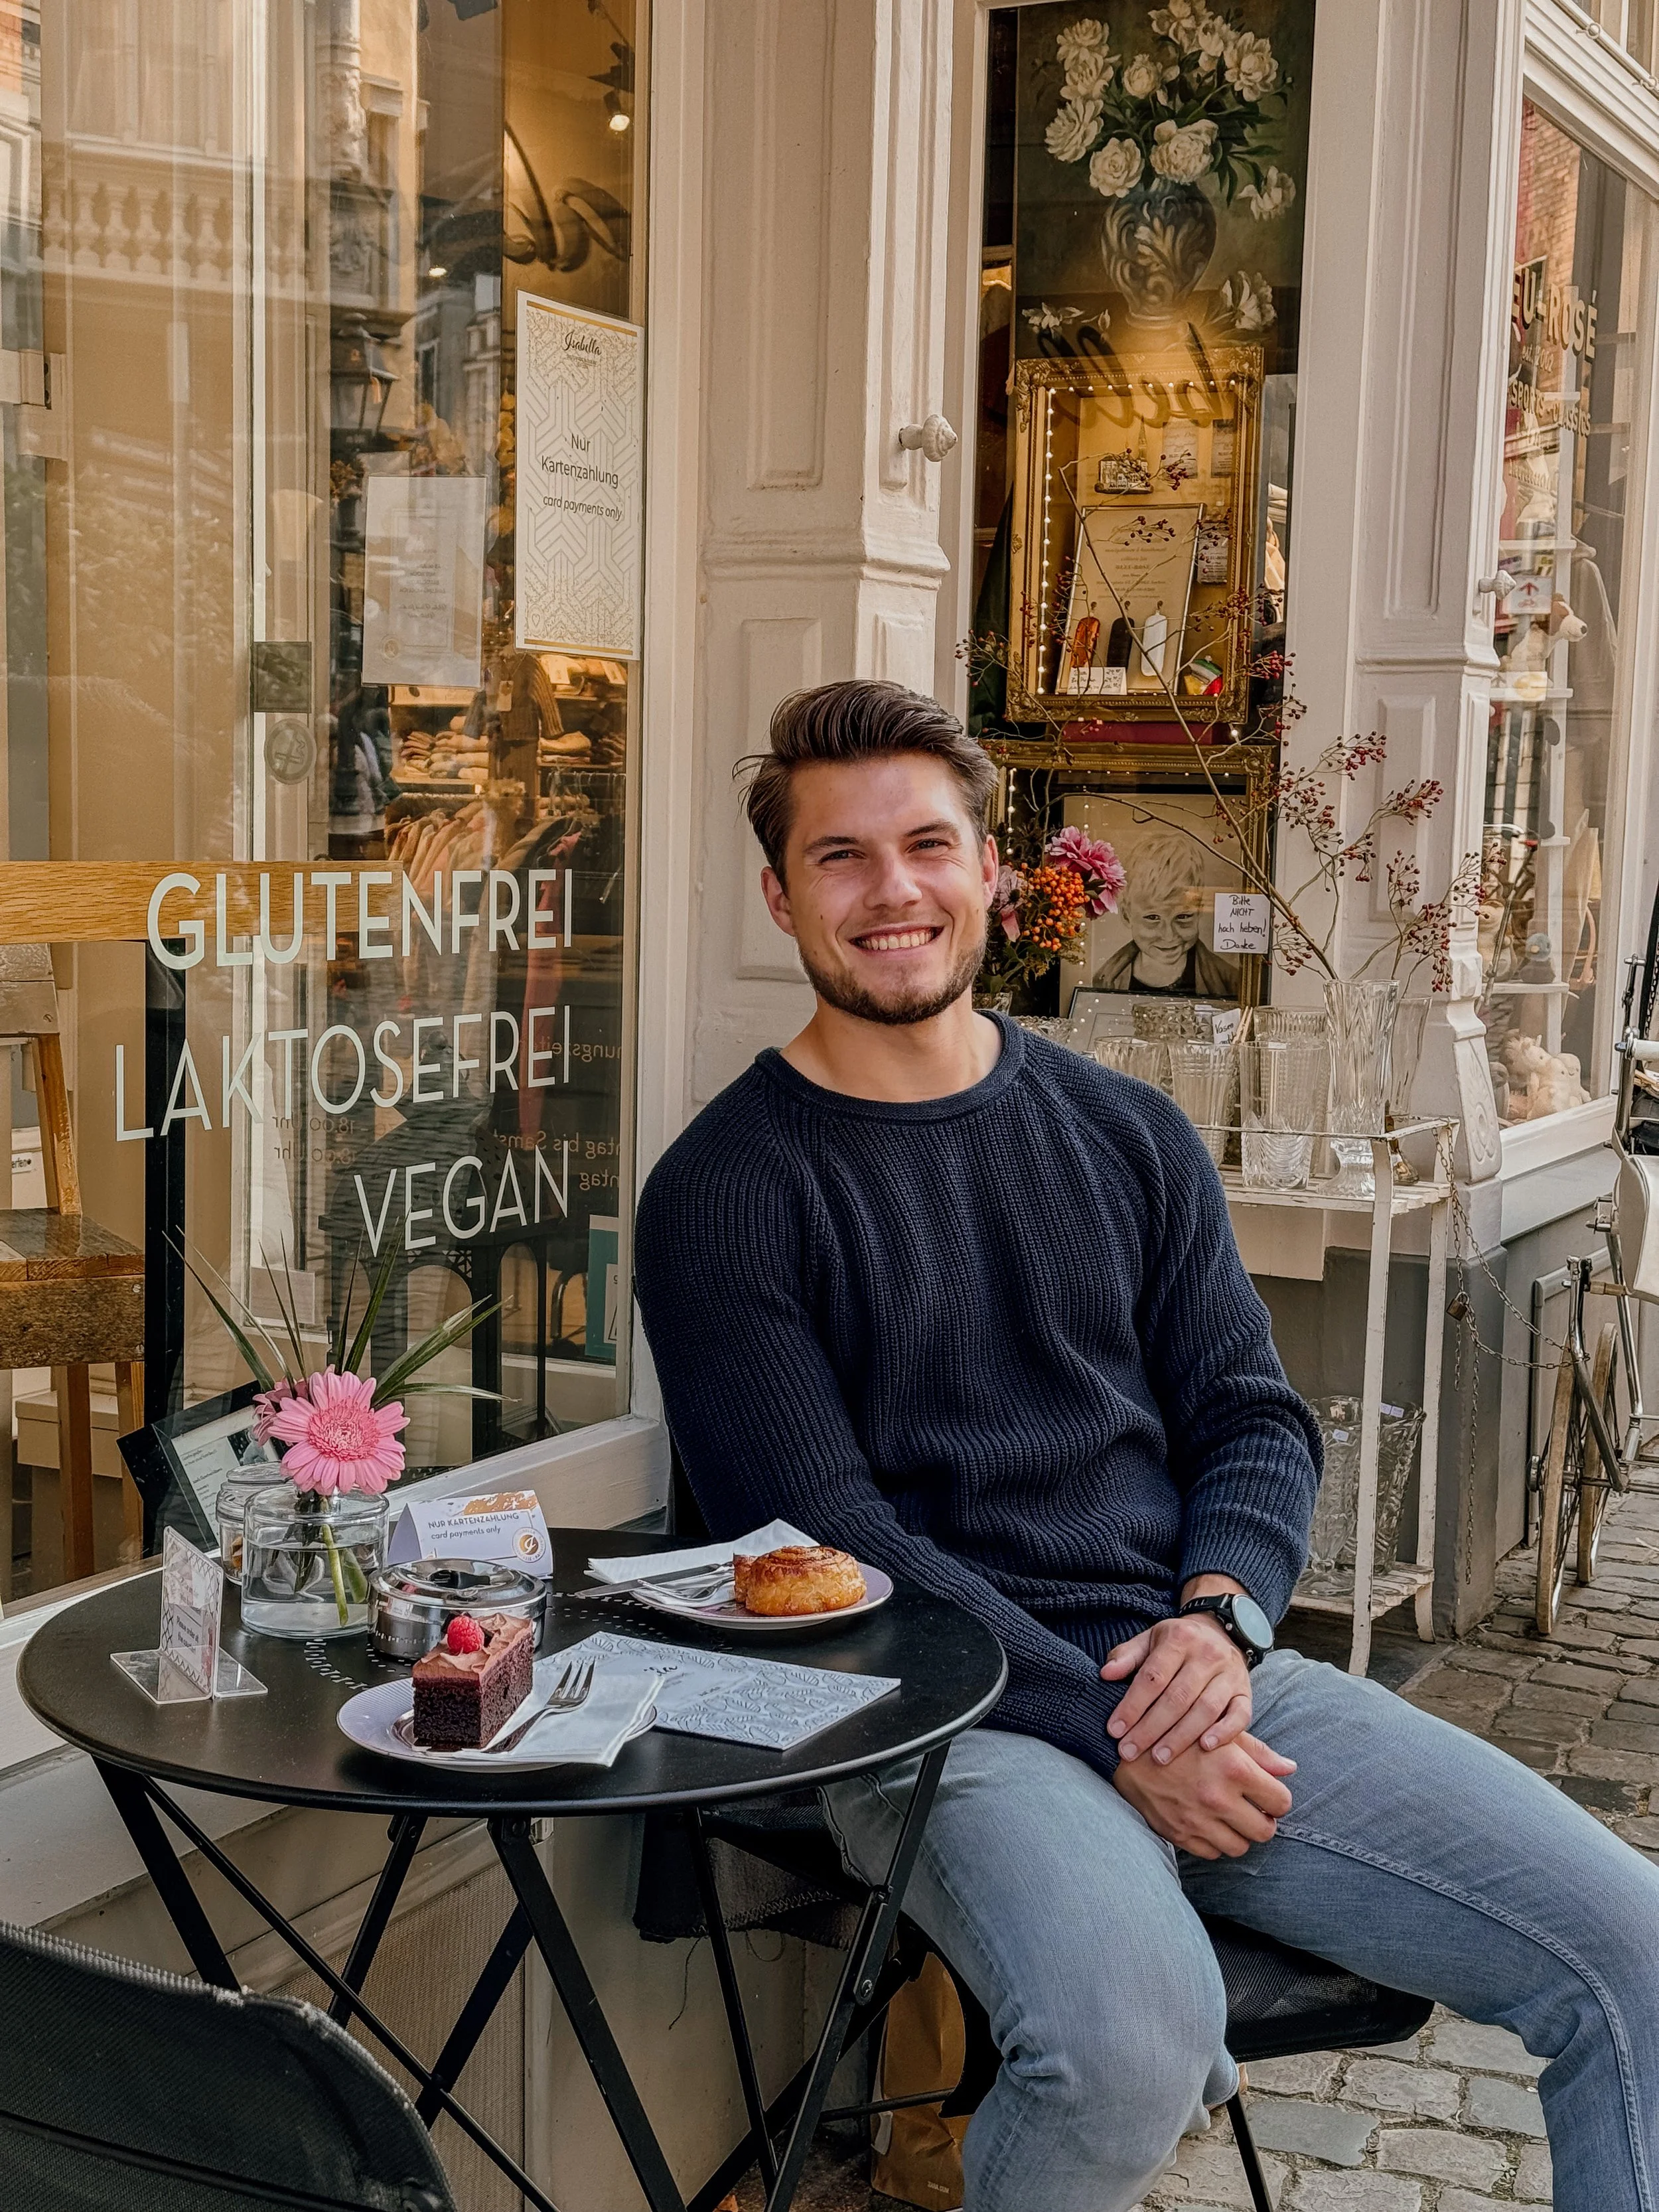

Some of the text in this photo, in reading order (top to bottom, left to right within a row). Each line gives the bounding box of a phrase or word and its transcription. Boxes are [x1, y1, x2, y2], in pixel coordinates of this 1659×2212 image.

[563, 329, 602, 356] Isabella
[571, 433, 591, 453] Nur
[541, 455, 618, 489] Kartenzahlung
[543, 496, 622, 522] card payments only
[1229, 894, 1250, 905] Bitte
[147, 869, 573, 970] GLUTENFREI
[1230, 907, 1255, 917] NICHT
[1218, 918, 1266, 937] hoch heben!
[1220, 938, 1256, 950] Danke
[1215, 1020, 1234, 1034] Vasen
[115, 1005, 571, 1142] LAKTOSEFREI
[353, 1140, 569, 1258] VEGAN
[428, 1512, 520, 1529] NUR KARTENZAHLUNG
[431, 1524, 501, 1540] card payments only
